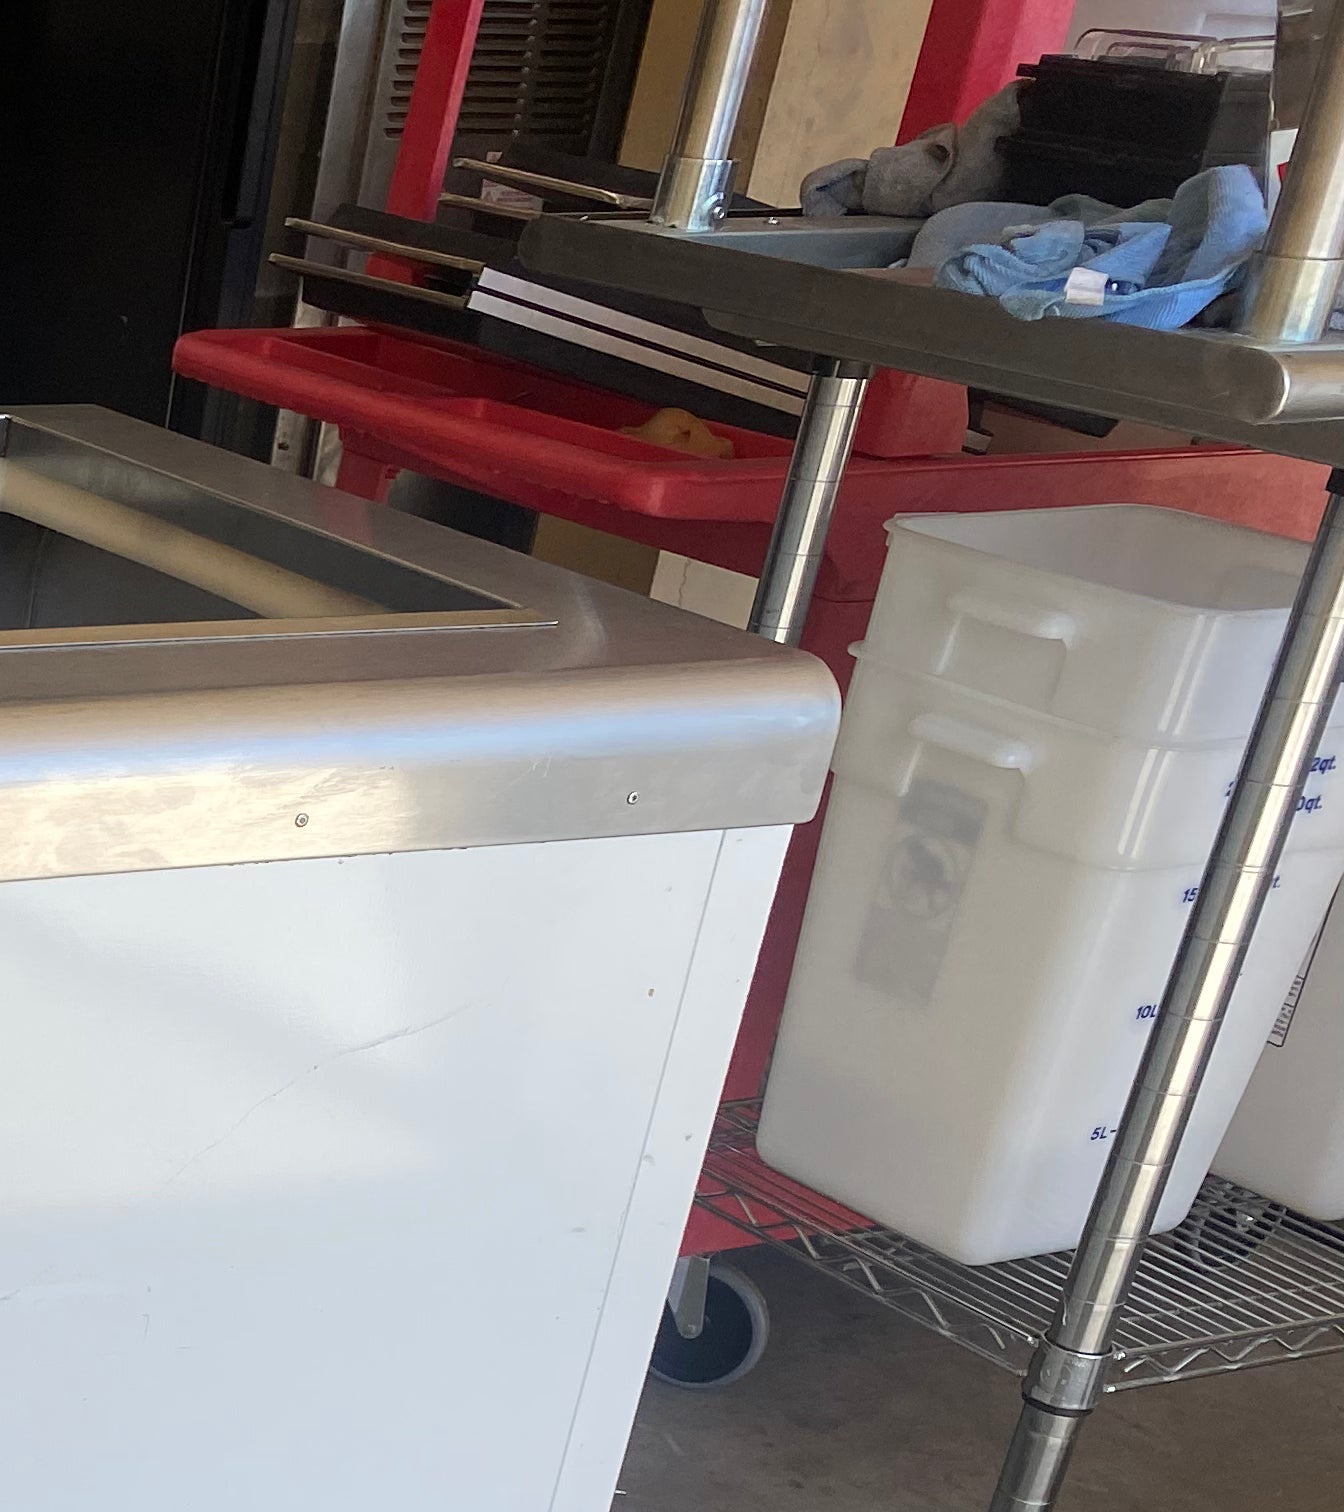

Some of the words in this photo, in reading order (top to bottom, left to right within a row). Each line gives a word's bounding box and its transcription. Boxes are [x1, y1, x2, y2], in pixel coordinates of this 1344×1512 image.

[1310, 755, 1337, 774] 2qt.
[1182, 887, 1199, 903] 15
[1135, 1004, 1159, 1020] 10L
[1090, 1126, 1108, 1141] 5L
